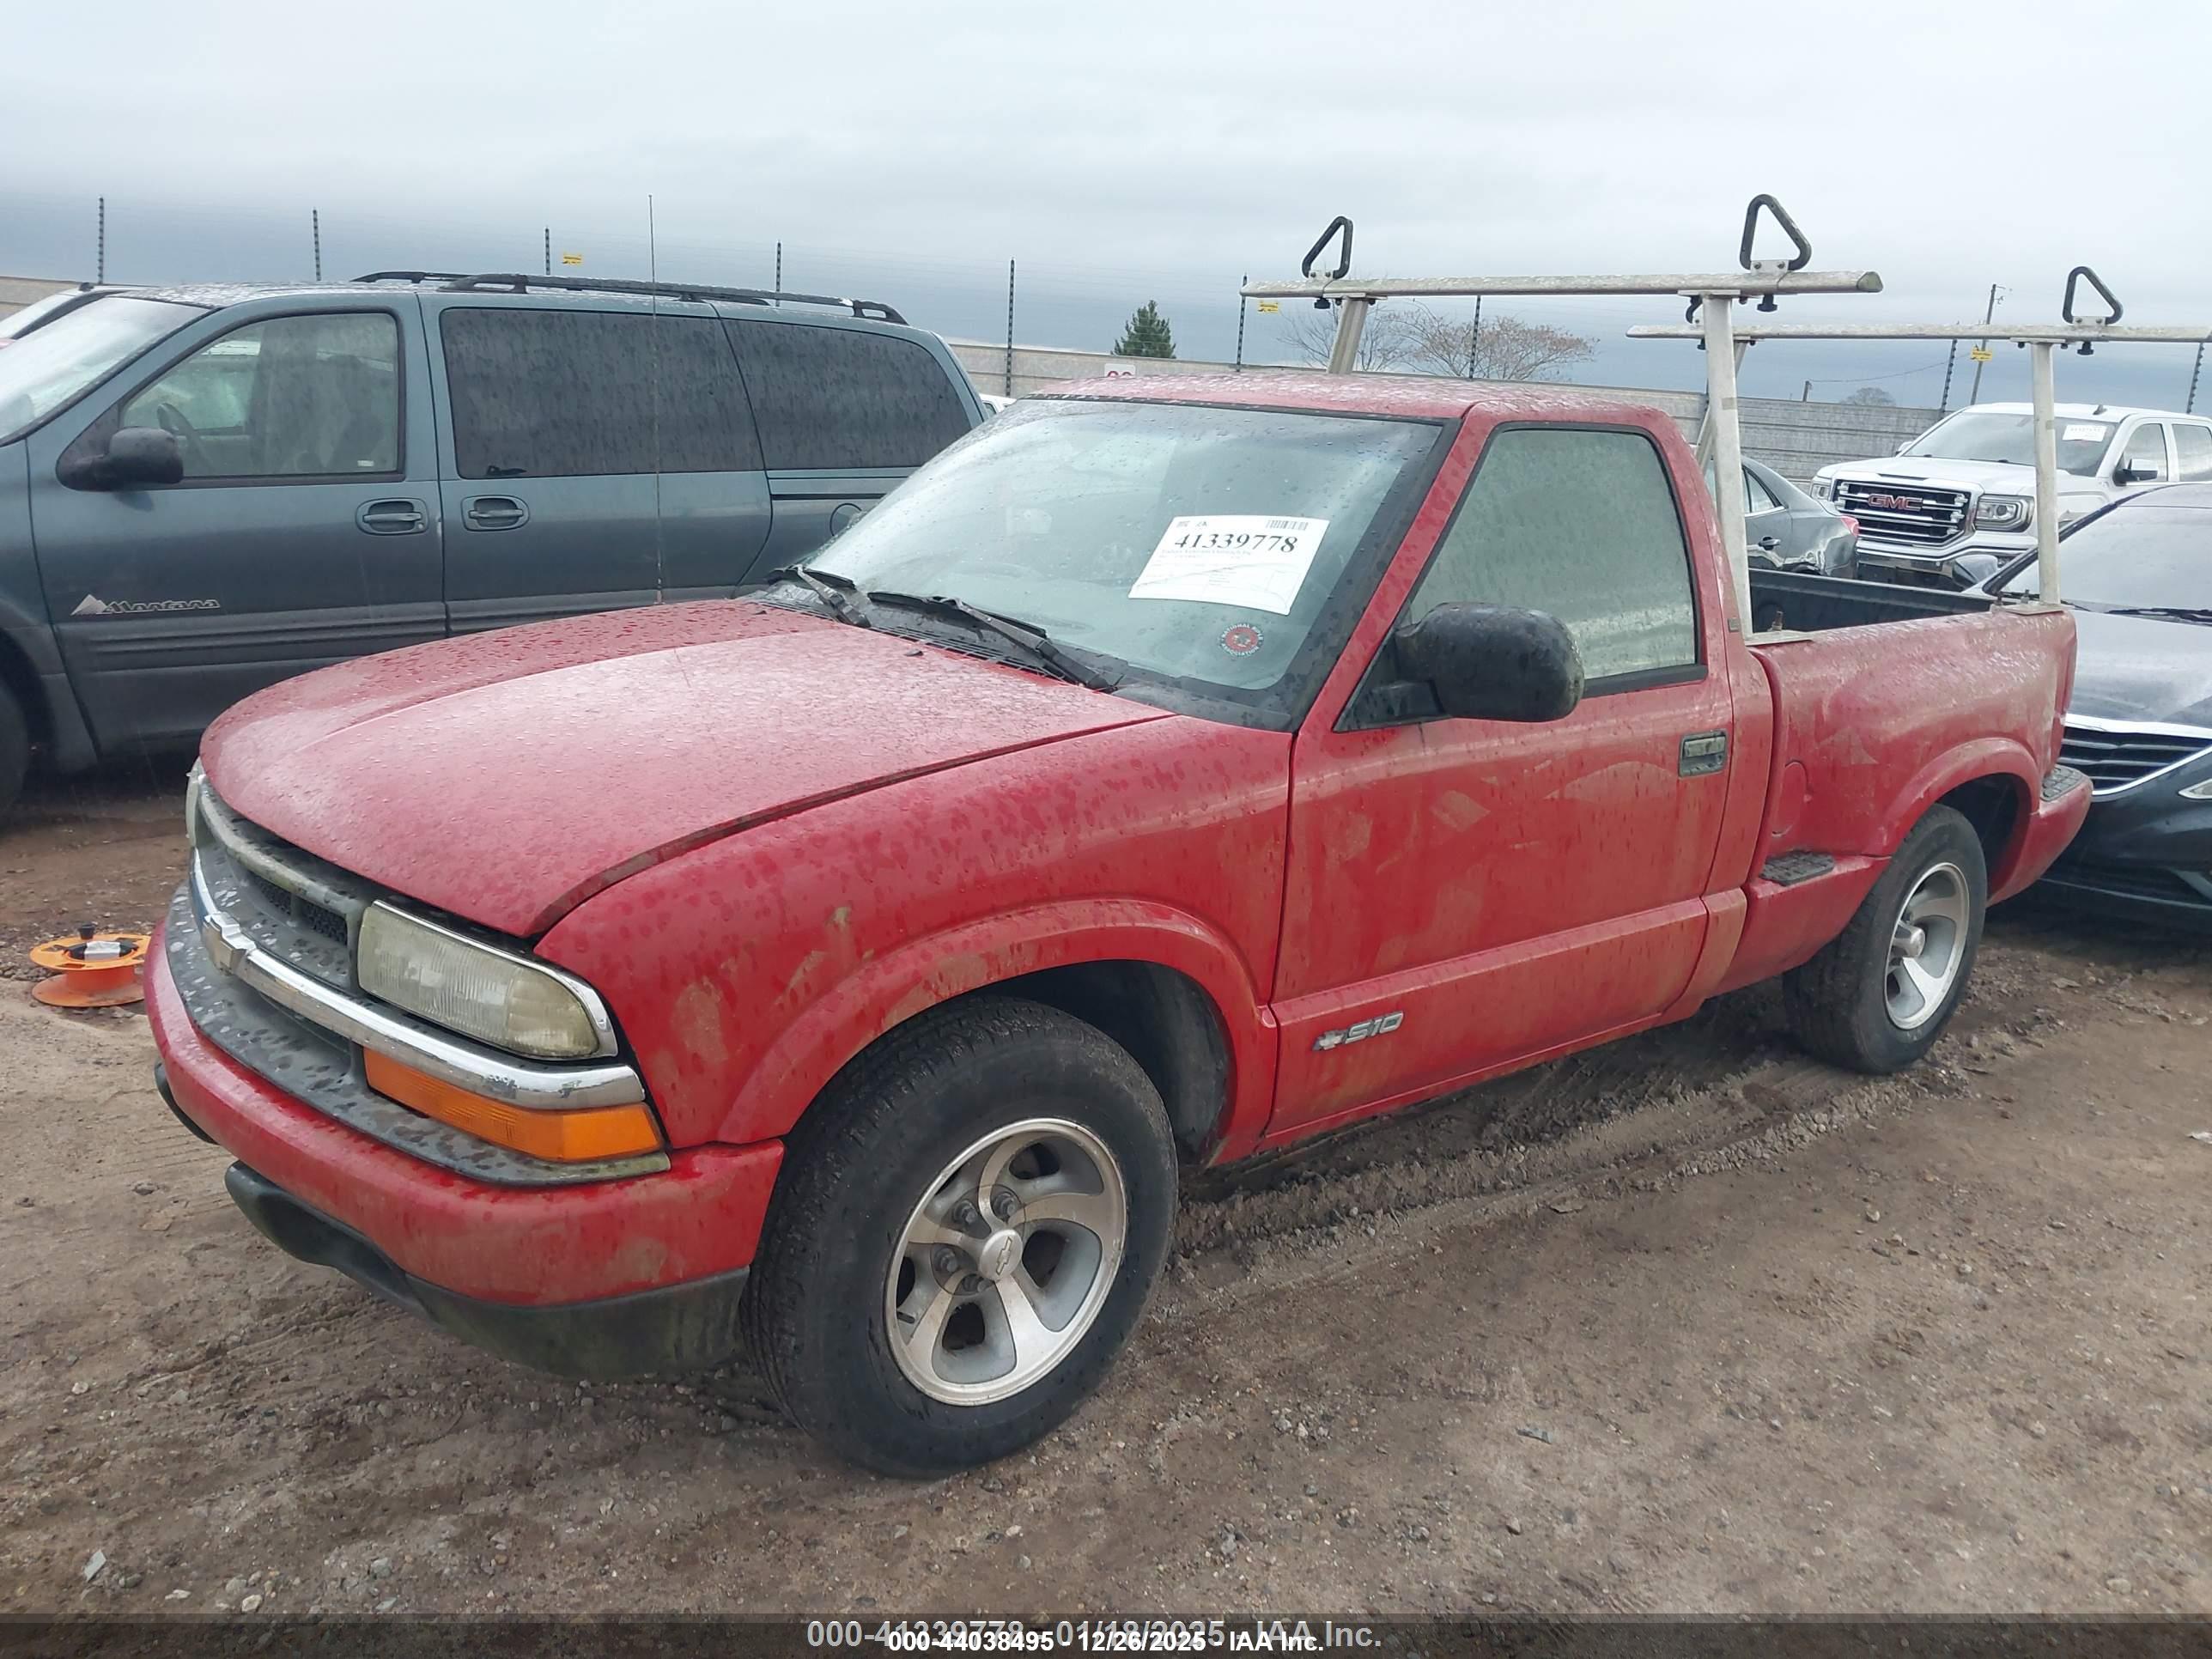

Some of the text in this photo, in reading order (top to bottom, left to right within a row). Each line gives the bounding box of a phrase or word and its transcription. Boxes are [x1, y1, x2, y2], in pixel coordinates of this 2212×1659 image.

[1868, 493, 1923, 511] GMC
[1174, 532, 1297, 553] 41339778
[100, 599, 221, 614] Montana
[1345, 1012, 1404, 1044] S10
